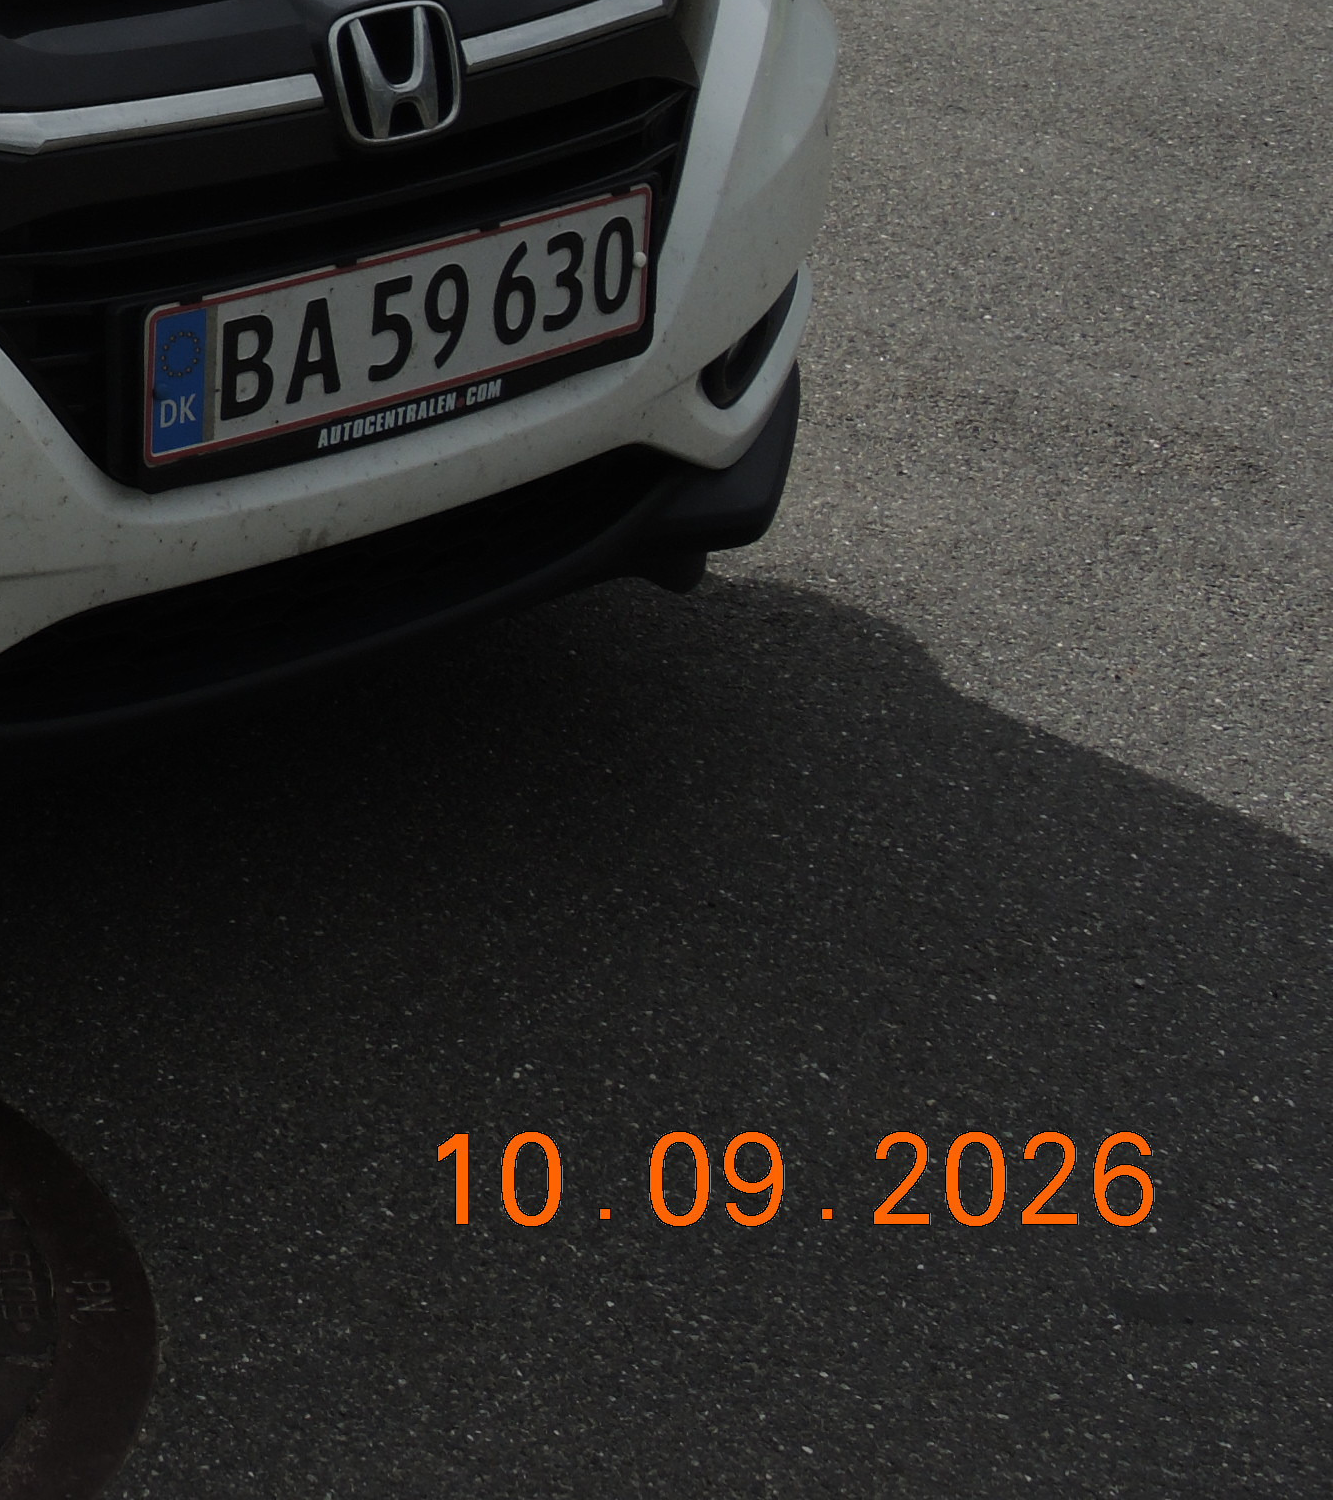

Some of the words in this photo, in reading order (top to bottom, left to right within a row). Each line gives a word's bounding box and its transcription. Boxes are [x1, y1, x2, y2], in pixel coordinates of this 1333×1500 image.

[220, 297, 341, 422] BA
[367, 263, 470, 383] 59
[492, 215, 635, 347] 630
[160, 393, 196, 430] DK
